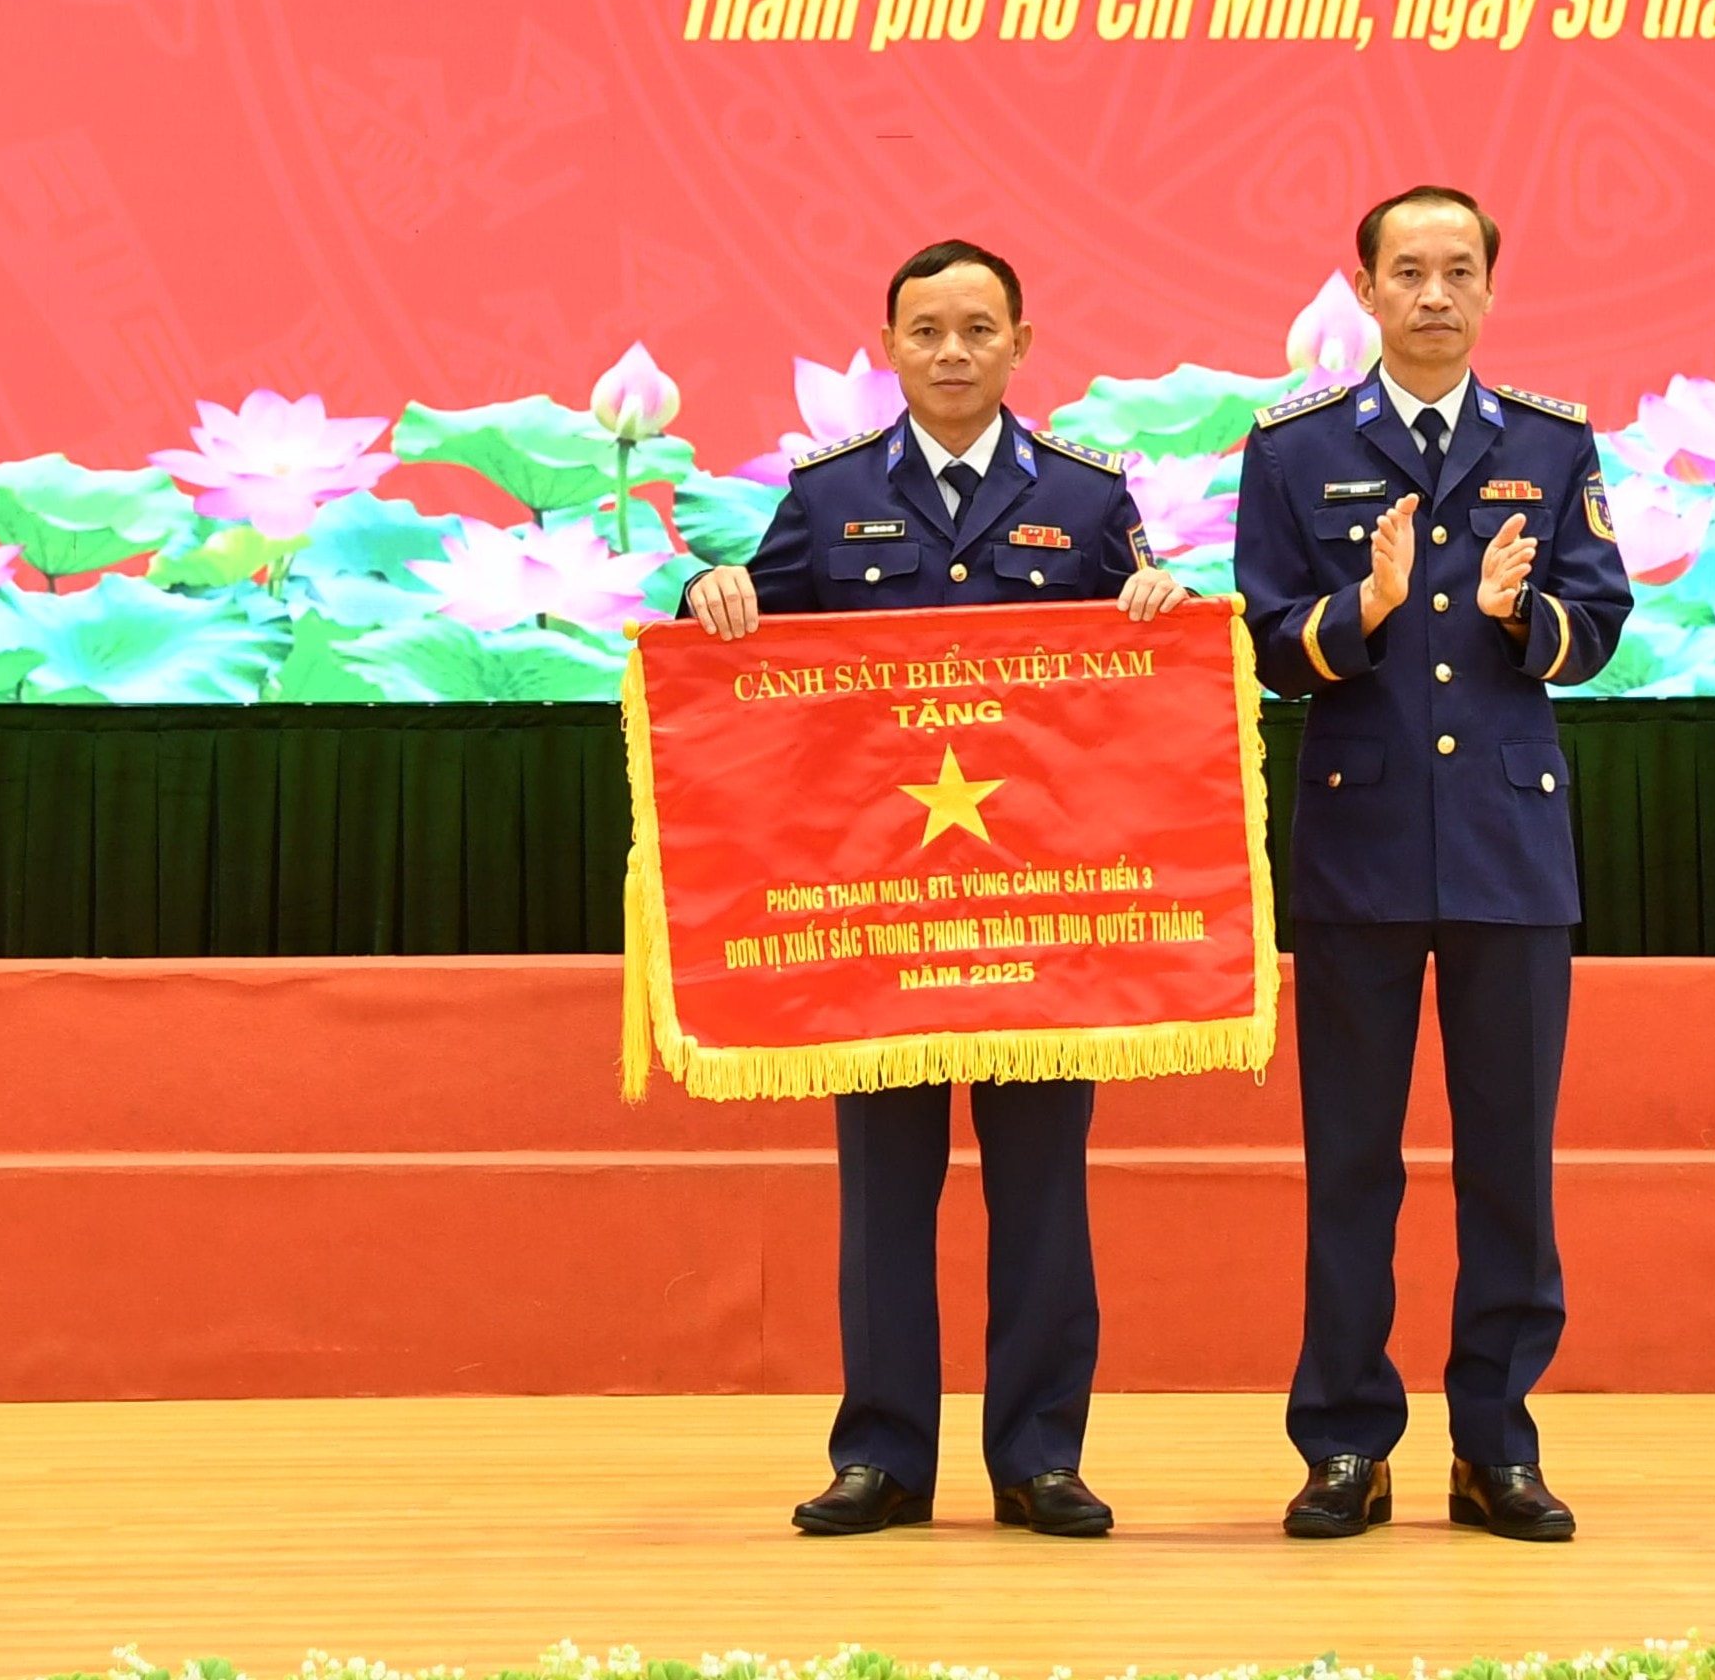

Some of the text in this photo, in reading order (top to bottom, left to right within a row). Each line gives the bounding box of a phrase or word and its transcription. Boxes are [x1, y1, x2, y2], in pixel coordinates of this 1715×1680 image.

[734, 643, 1157, 702] CẢNH SÁT BIỂN VIỆT NAM
[890, 697, 1004, 734] TẶNG
[766, 854, 1153, 913] PHÒNG THAM MƯU, BTL VÙNG CẢNH SÁT BIỂN 3
[724, 901, 1205, 973] ĐƠN VỊ XUẤT SẮC TRONG PHONG TRÀO THI ĐUA QUYẾT THẮNG
[899, 961, 1036, 991] NĂM 2025
